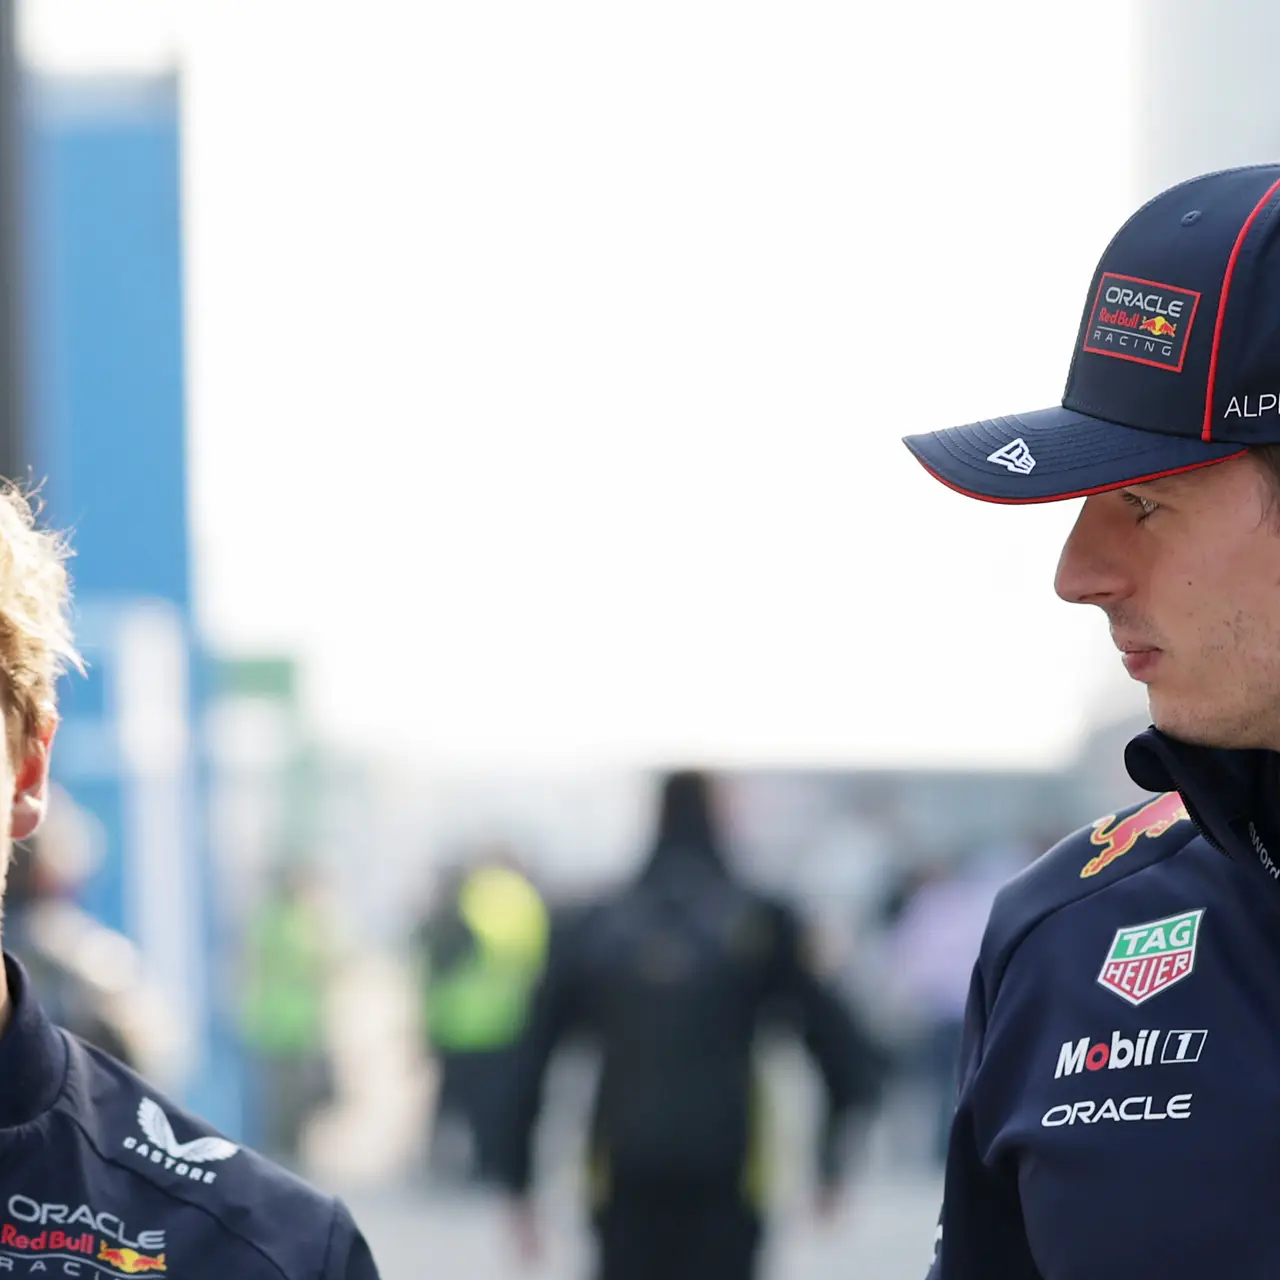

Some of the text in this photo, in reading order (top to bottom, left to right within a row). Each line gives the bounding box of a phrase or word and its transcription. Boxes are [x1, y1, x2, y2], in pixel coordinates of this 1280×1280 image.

[1098, 307, 1140, 328] Red Bull
[1105, 286, 1184, 317] ORACLE
[1093, 330, 1172, 356] RACING
[1121, 918, 1193, 955] TAG
[1104, 952, 1190, 998] HEUER
[1054, 1029, 1161, 1079] Mobil
[1041, 1093, 1193, 1127] ORACLE
[122, 1136, 217, 1184] CASTORE
[0, 1223, 94, 1255] Red Bull
[7, 1194, 167, 1250] ORACLE
